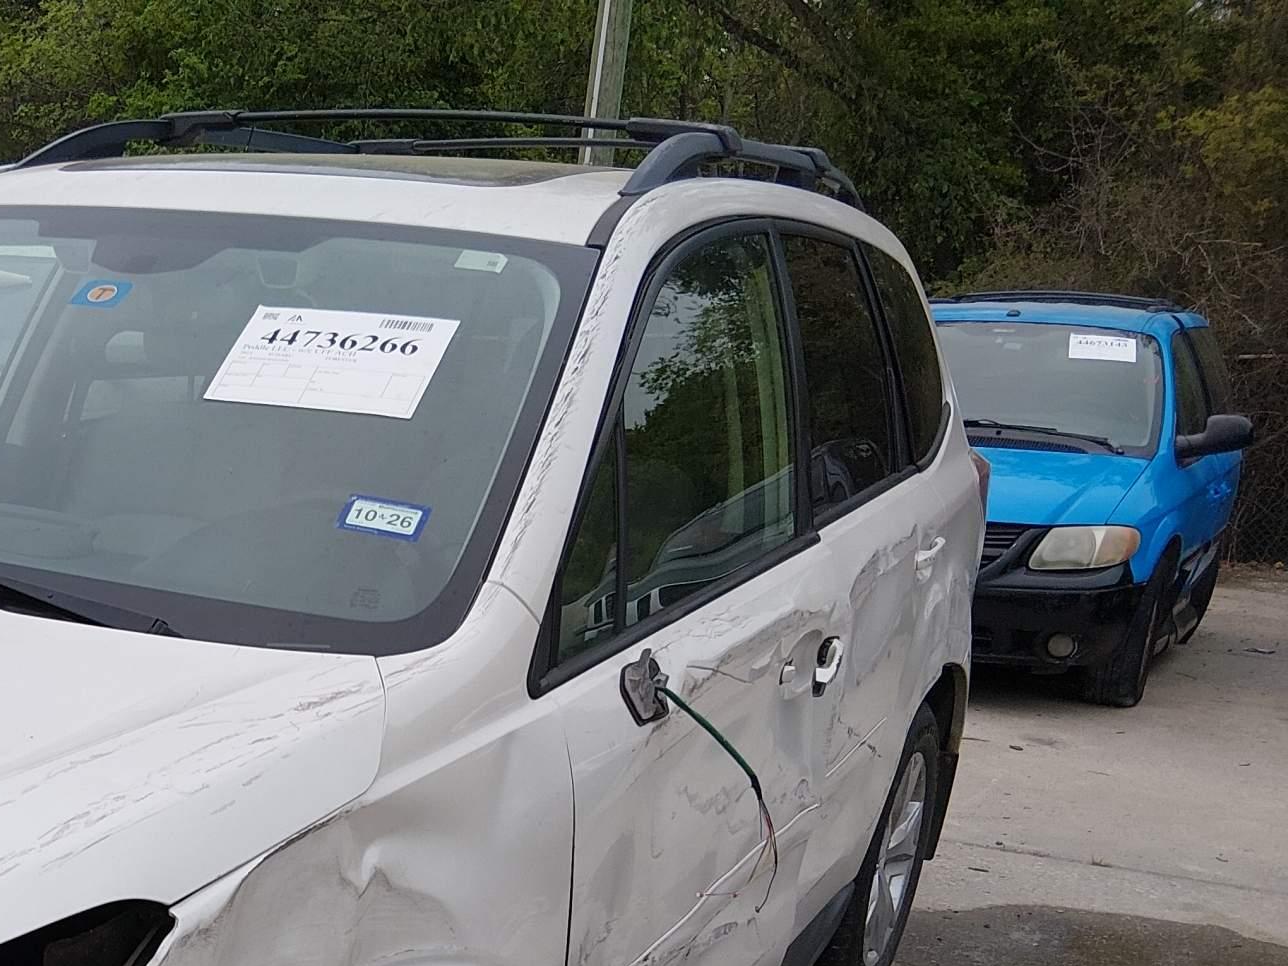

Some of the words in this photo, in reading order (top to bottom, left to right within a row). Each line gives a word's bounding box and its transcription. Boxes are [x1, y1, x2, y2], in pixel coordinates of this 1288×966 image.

[261, 328, 421, 356] 44736266
[353, 507, 378, 522] 10
[386, 513, 414, 529] 26
